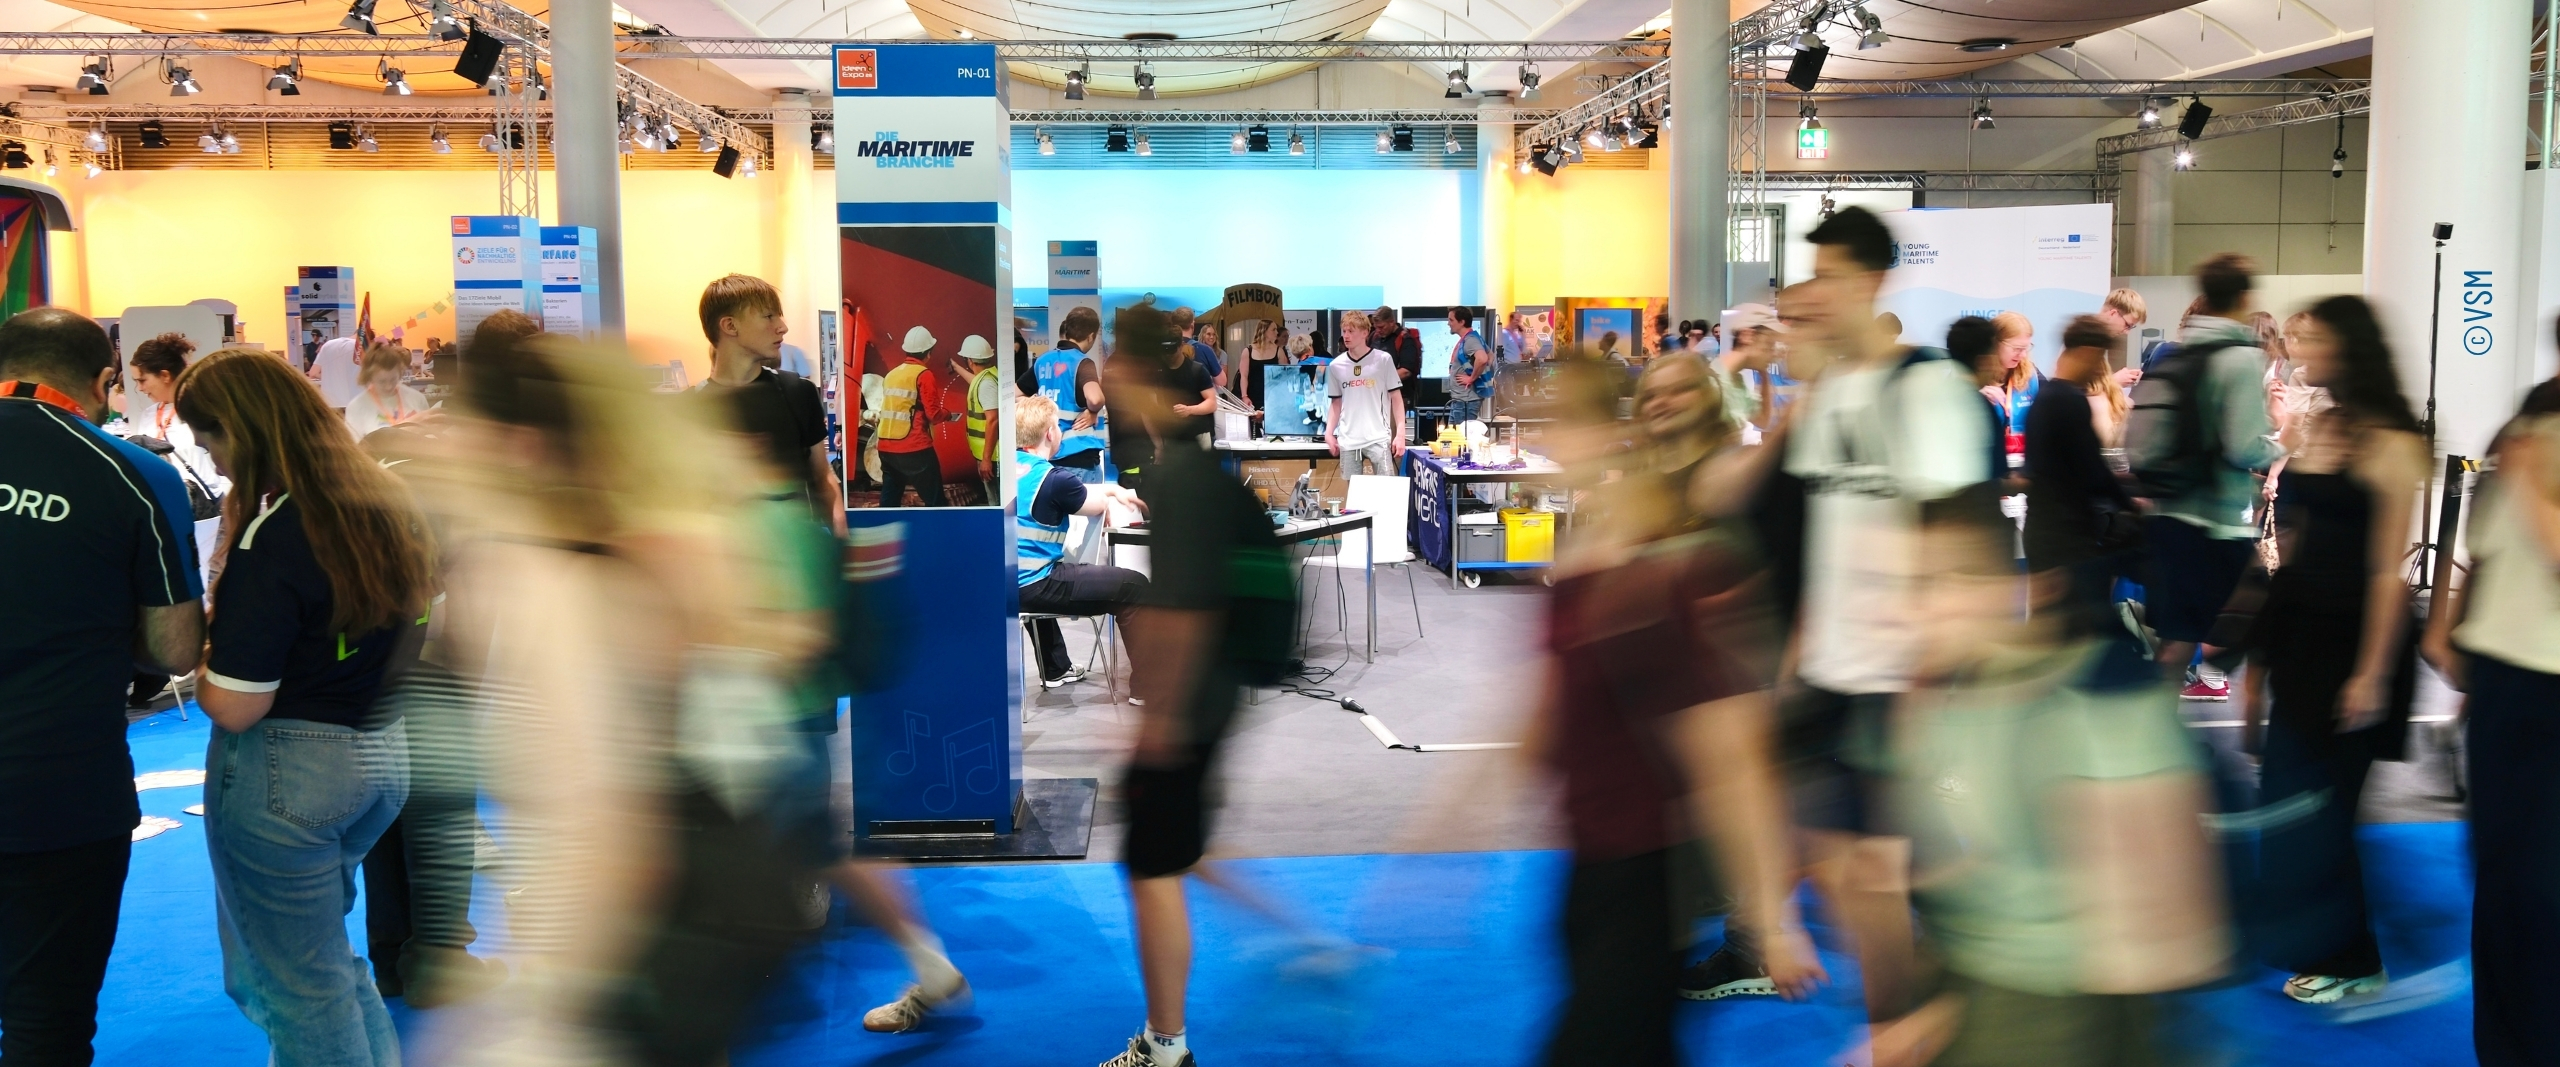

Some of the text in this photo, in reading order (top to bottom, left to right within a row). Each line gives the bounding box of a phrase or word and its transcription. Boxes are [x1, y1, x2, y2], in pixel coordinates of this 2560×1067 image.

[957, 67, 991, 79] PN-01
[875, 131, 899, 142] DIE
[857, 141, 975, 157] MARITIME
[876, 157, 955, 168] BRANCHE
[1227, 288, 1280, 308] FILMBOX
